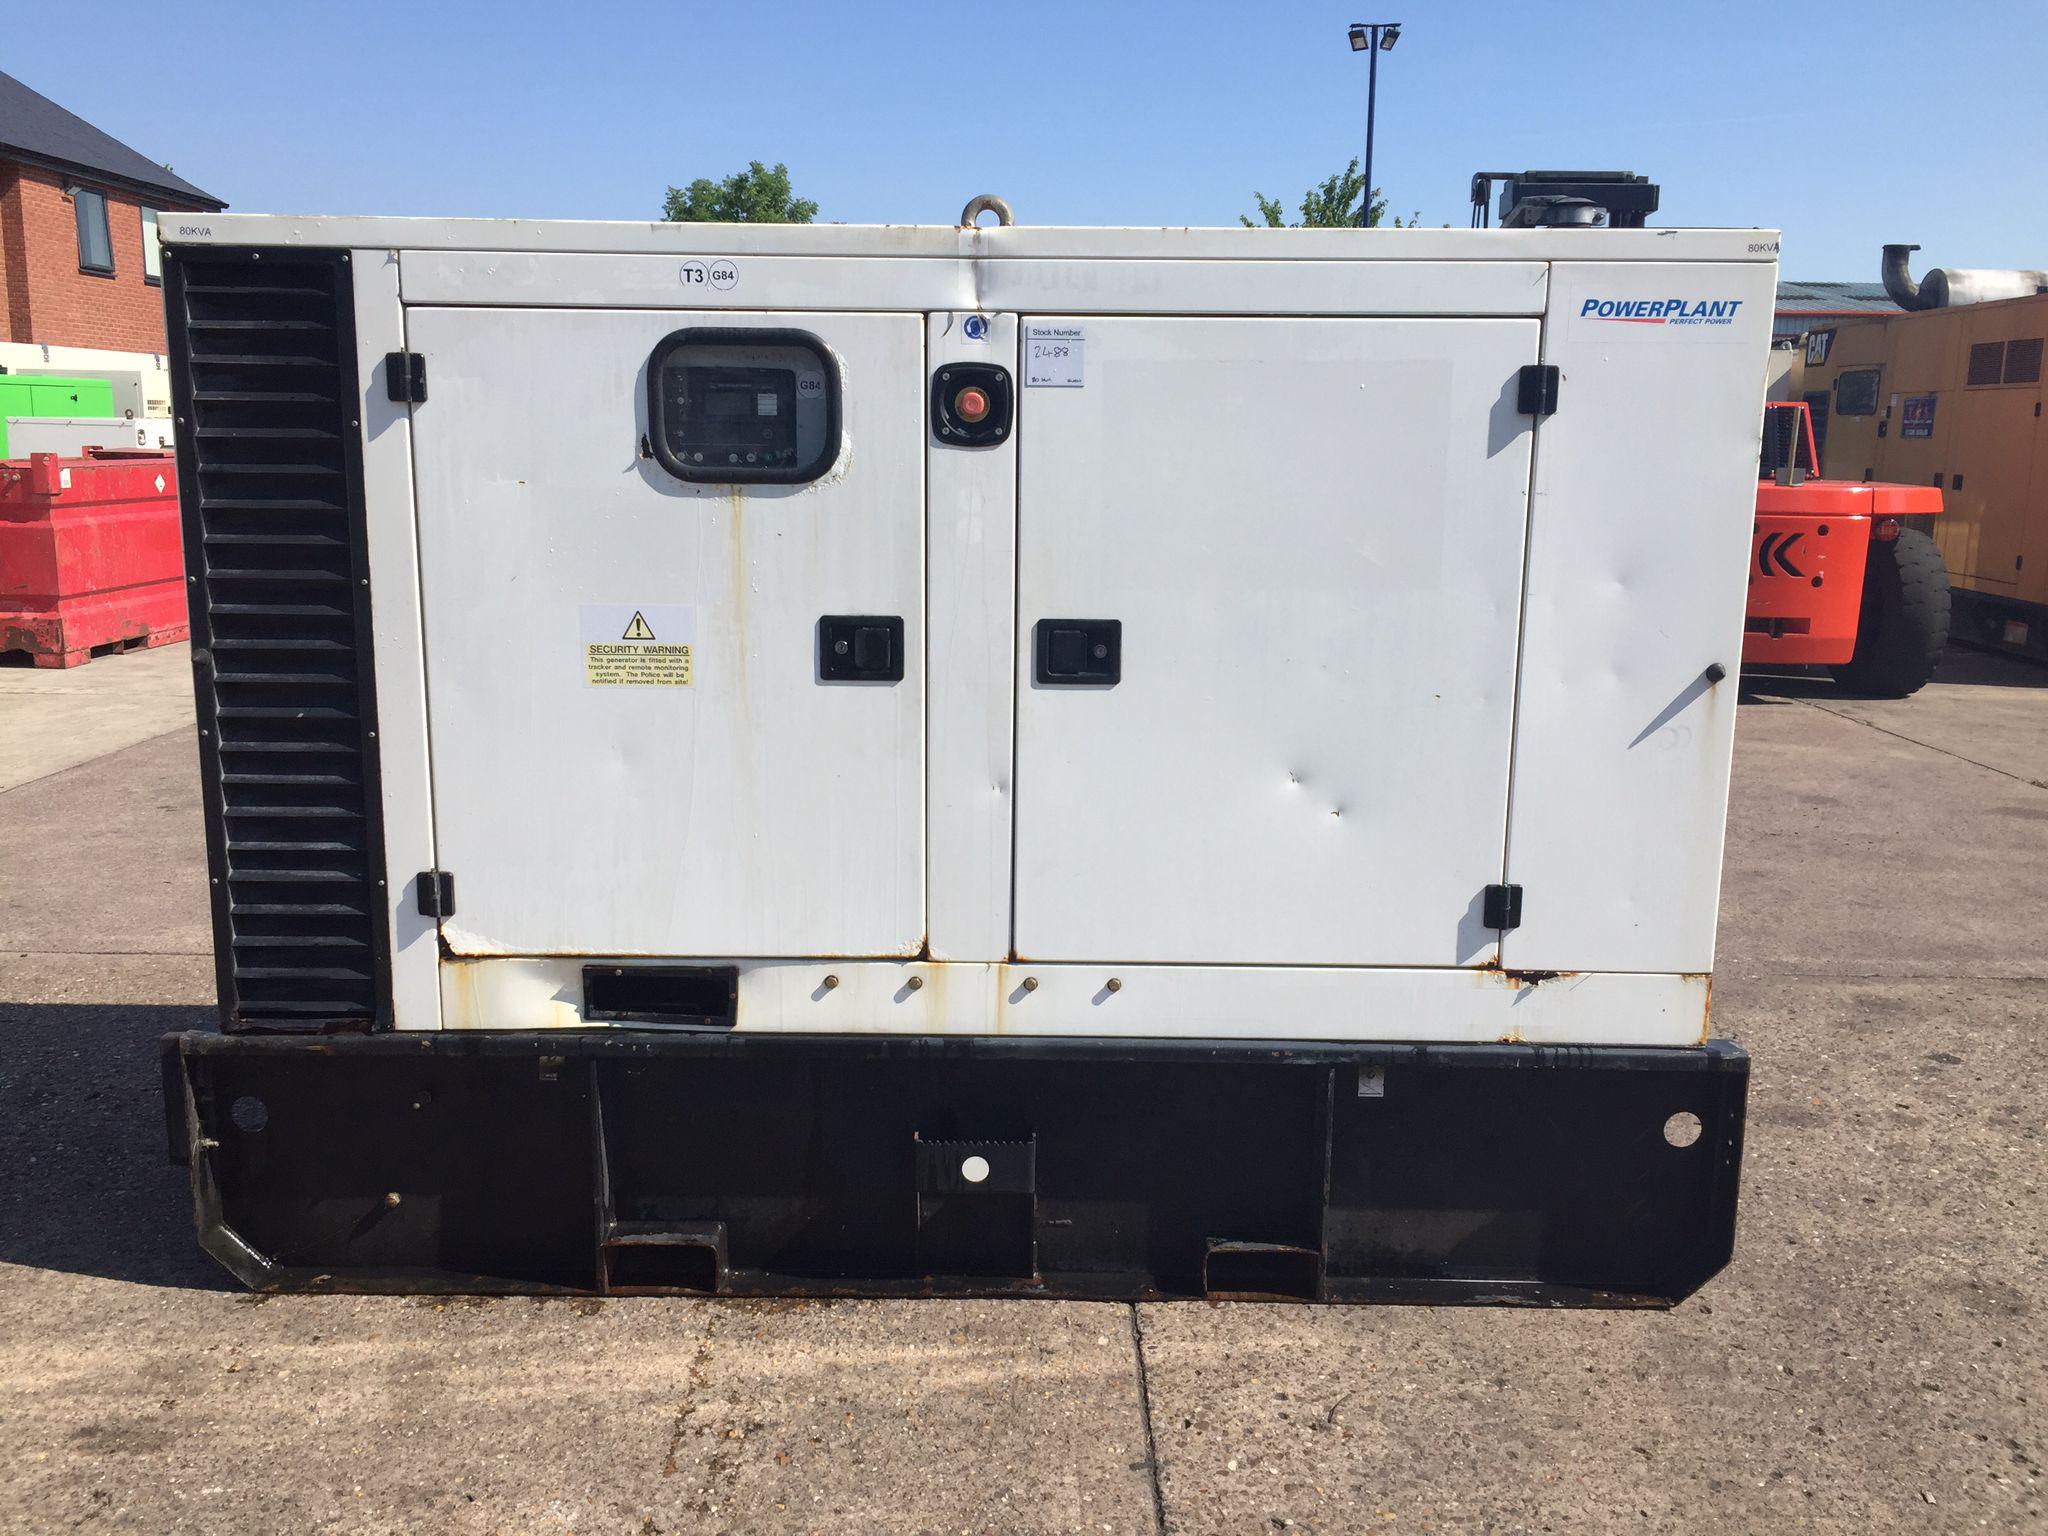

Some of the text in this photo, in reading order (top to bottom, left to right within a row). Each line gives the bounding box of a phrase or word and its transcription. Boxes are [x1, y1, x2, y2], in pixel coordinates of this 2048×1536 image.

[179, 226, 212, 236] 80KVA
[1747, 242, 1780, 253] 80KVA
[683, 268, 704, 283] T3
[712, 270, 735, 281] G84
[1032, 328, 1081, 337] Stock Number
[1034, 345, 1069, 358] 2488
[1807, 333, 1829, 364] CAT
[800, 381, 821, 390] G84
[589, 644, 689, 655] SECURITY WARNING
[654, 664, 689, 672] monitoring
[657, 678, 673, 686] from
